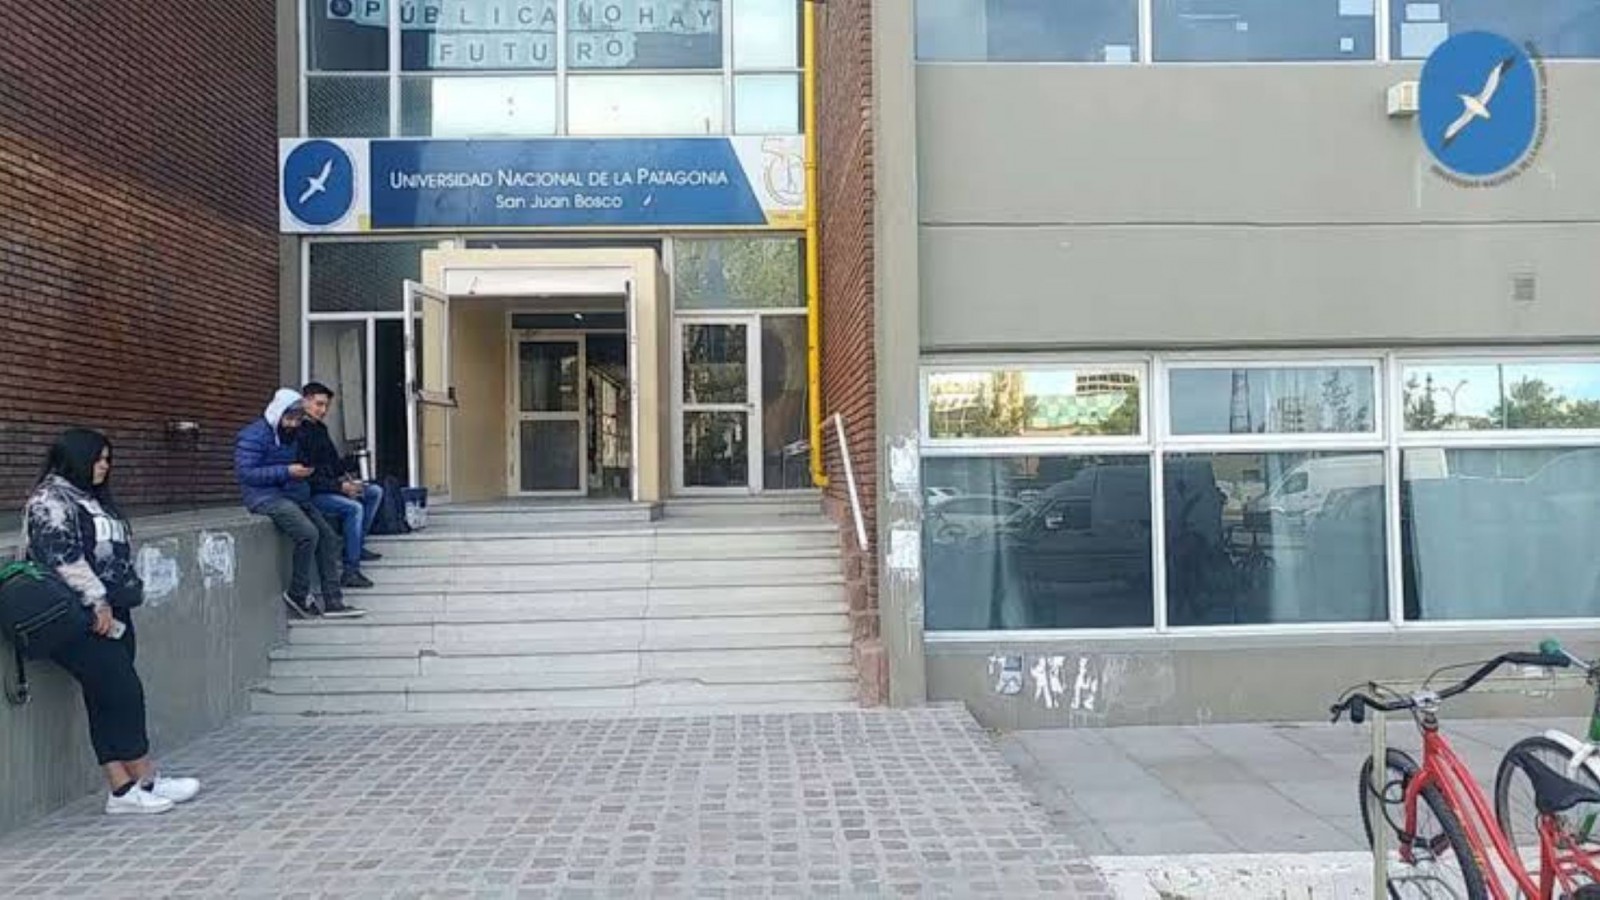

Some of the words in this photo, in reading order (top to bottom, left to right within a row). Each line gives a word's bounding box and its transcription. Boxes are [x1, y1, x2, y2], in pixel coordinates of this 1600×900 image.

[639, 8, 711, 27] HAY
[439, 40, 623, 63] FUTURO
[389, 171, 493, 189] UNIVERSIDAD
[498, 169, 584, 187] NACIONAL
[588, 171, 609, 186] DE
[613, 171, 633, 185] LA
[637, 167, 729, 186] PATAGONIA
[496, 194, 525, 209] San
[530, 193, 570, 209] Juan
[574, 194, 623, 209] Bosco
